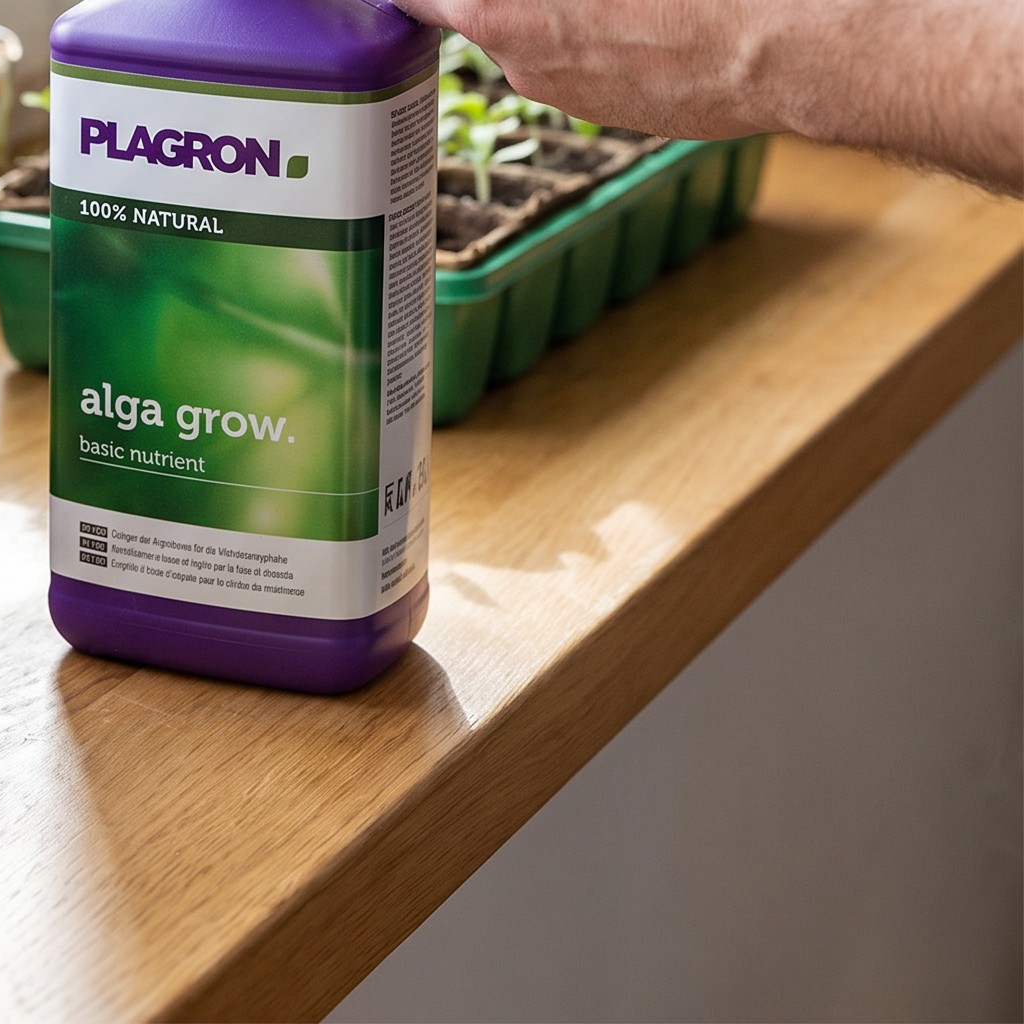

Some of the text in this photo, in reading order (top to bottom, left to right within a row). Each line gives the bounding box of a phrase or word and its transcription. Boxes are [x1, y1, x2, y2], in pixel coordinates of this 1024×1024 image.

[80, 117, 280, 178] PLAGRON
[79, 199, 224, 234] 100% NATURAL
[80, 382, 295, 444] alga grow.
[79, 435, 206, 473] basic nutrient
